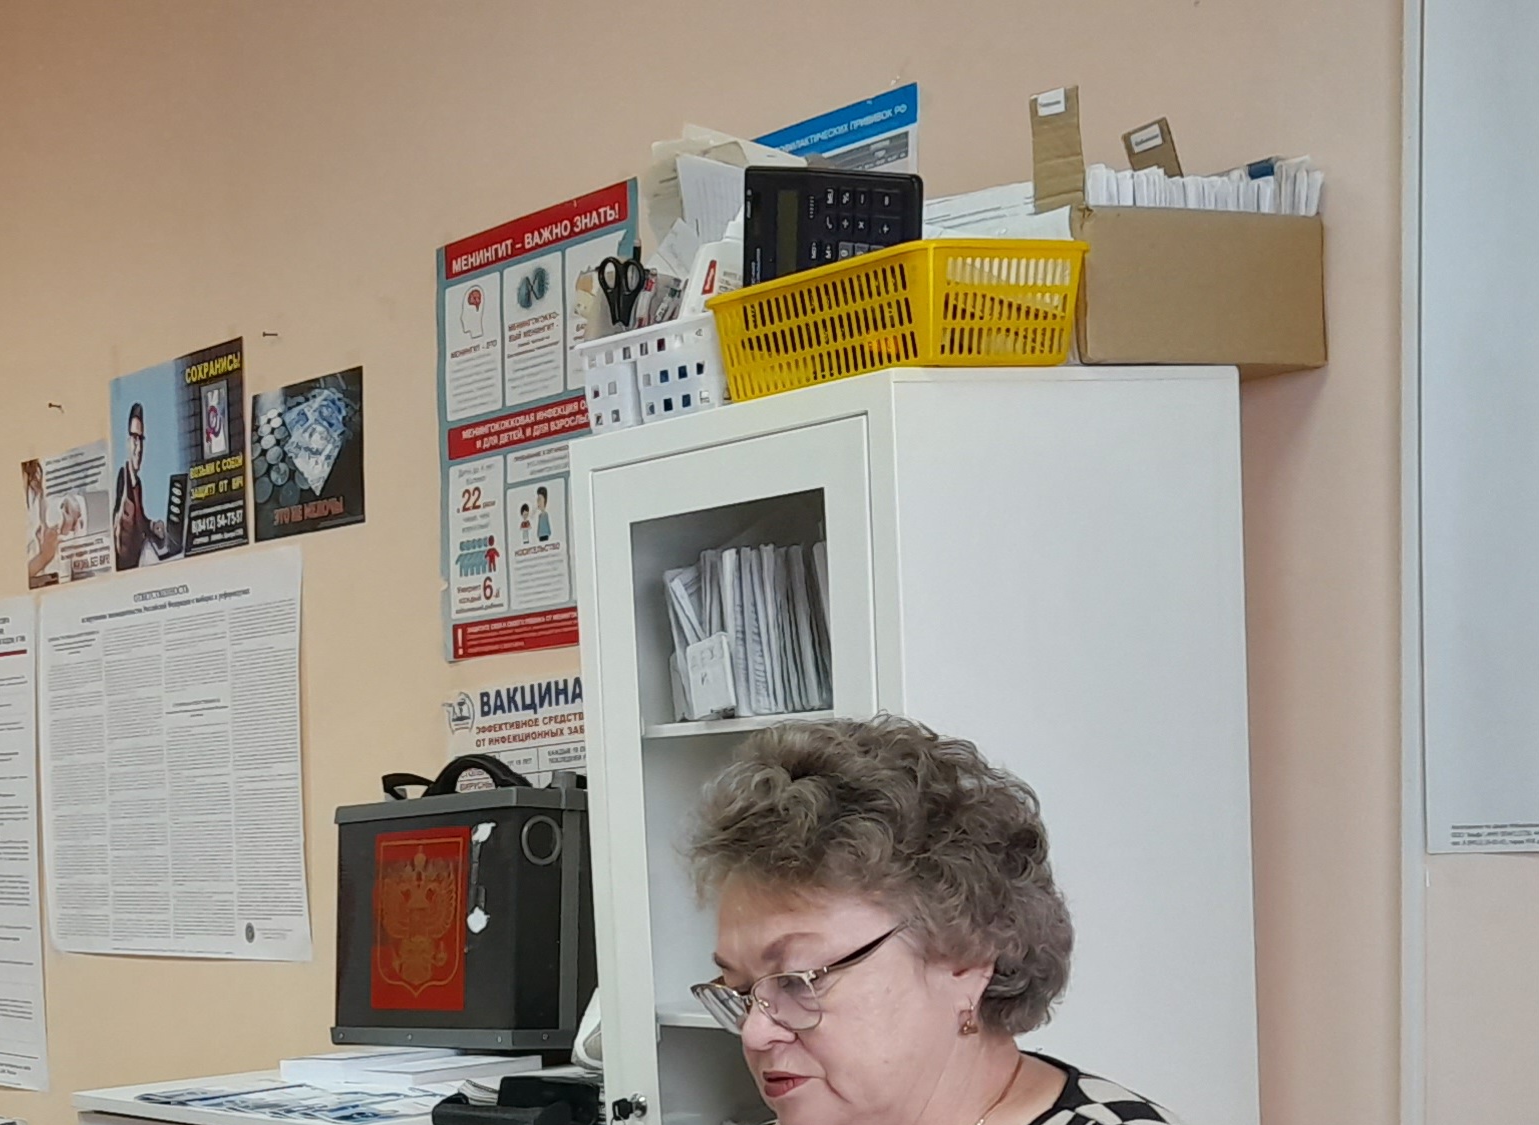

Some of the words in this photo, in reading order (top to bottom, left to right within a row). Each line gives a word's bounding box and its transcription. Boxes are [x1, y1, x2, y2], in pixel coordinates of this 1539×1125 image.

[452, 239, 513, 274] МЕНИНГИТ
[524, 220, 571, 250] ВАЖНО
[572, 202, 620, 233] ЗНАТЬ!
[218, 479, 229, 493] ОТ
[462, 487, 482, 511] 22
[479, 676, 584, 718] ВАКЦИНА
[475, 717, 540, 735] ЭФФЕКТИВНОЕ
[475, 738, 486, 748] ОТ
[488, 728, 565, 747] ИНФЕКЦИОННЫХ
